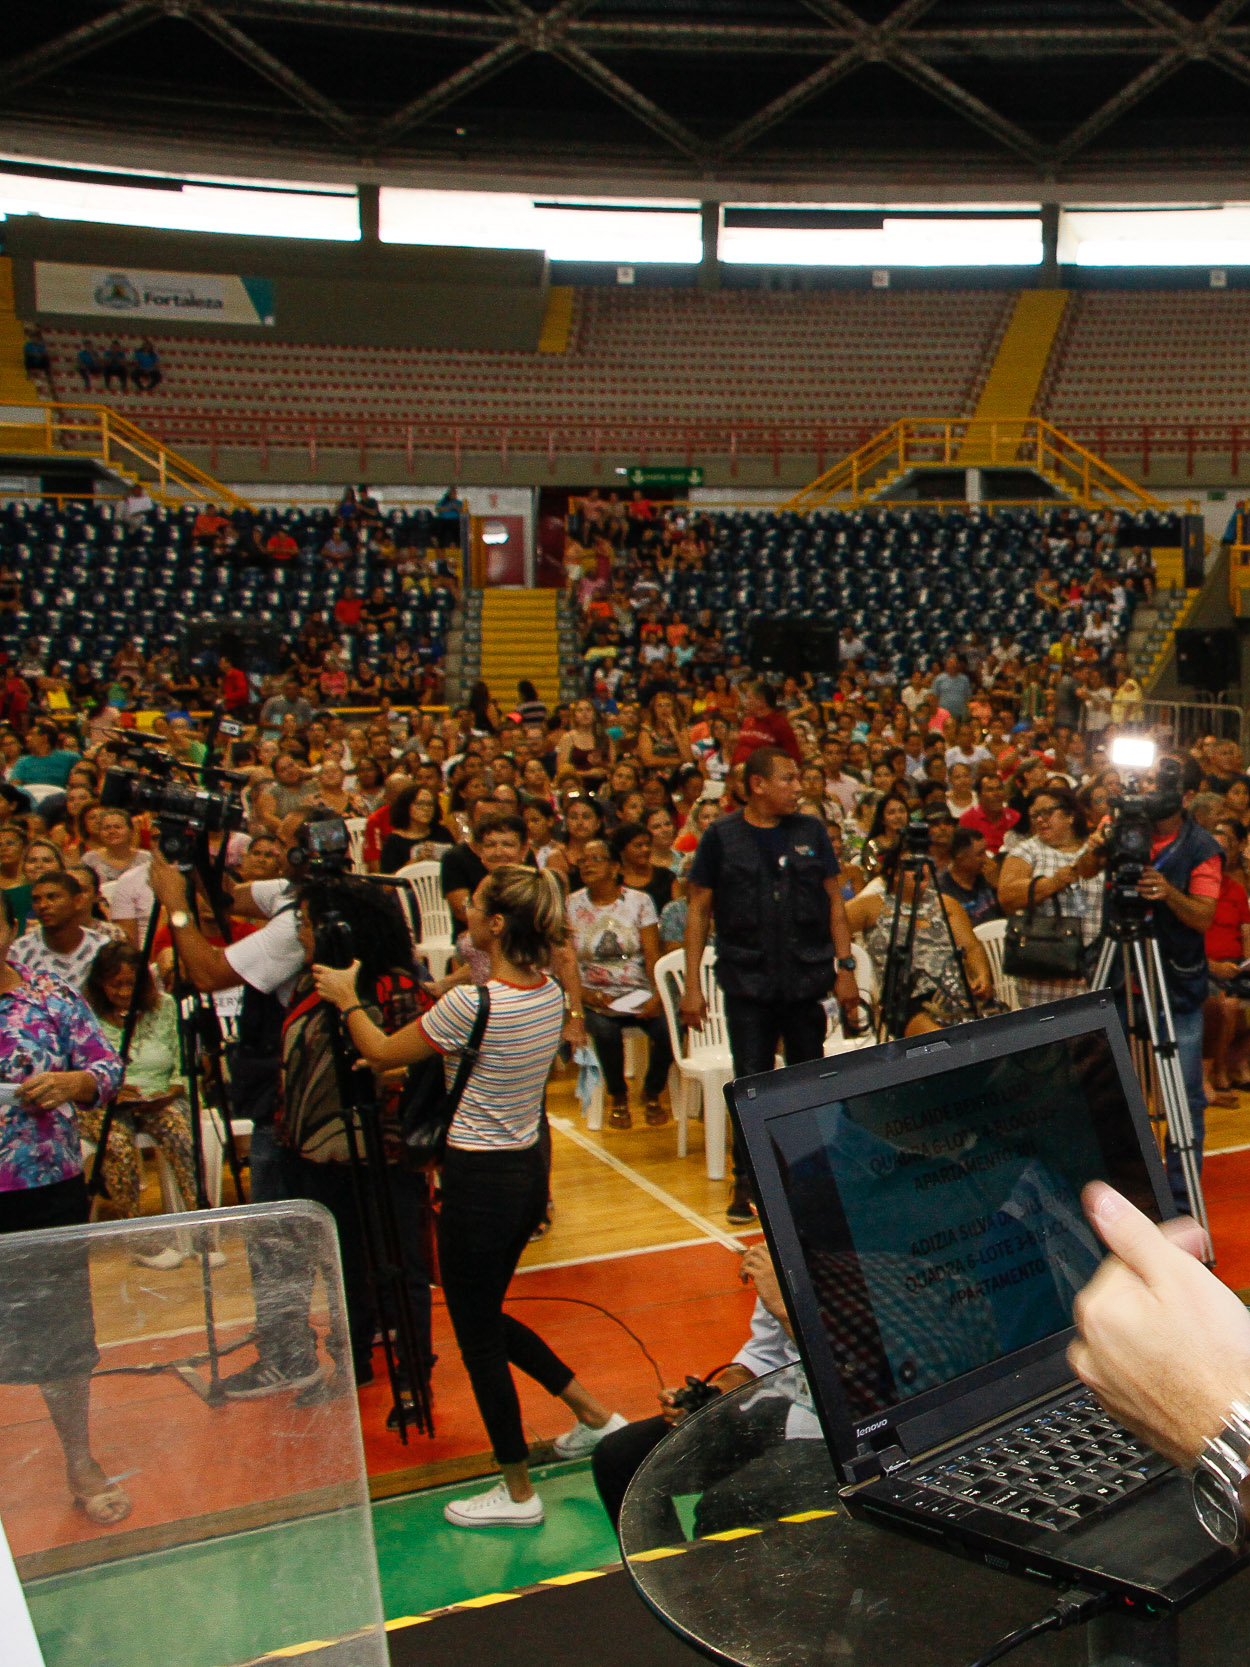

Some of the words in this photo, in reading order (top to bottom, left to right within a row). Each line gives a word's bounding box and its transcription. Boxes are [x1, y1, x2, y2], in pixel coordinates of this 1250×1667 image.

[143, 290, 224, 310] Fortaleza
[884, 1105, 951, 1138] ADELAIDE
[913, 1148, 1012, 1192] APARTAMENTO
[911, 1229, 957, 1257] ADIZIA
[958, 1214, 995, 1240] SILVA
[967, 1240, 1013, 1270] 6-LOTE
[948, 1258, 1046, 1307] APARTAMENTO
[856, 1418, 888, 1438] lenovo
